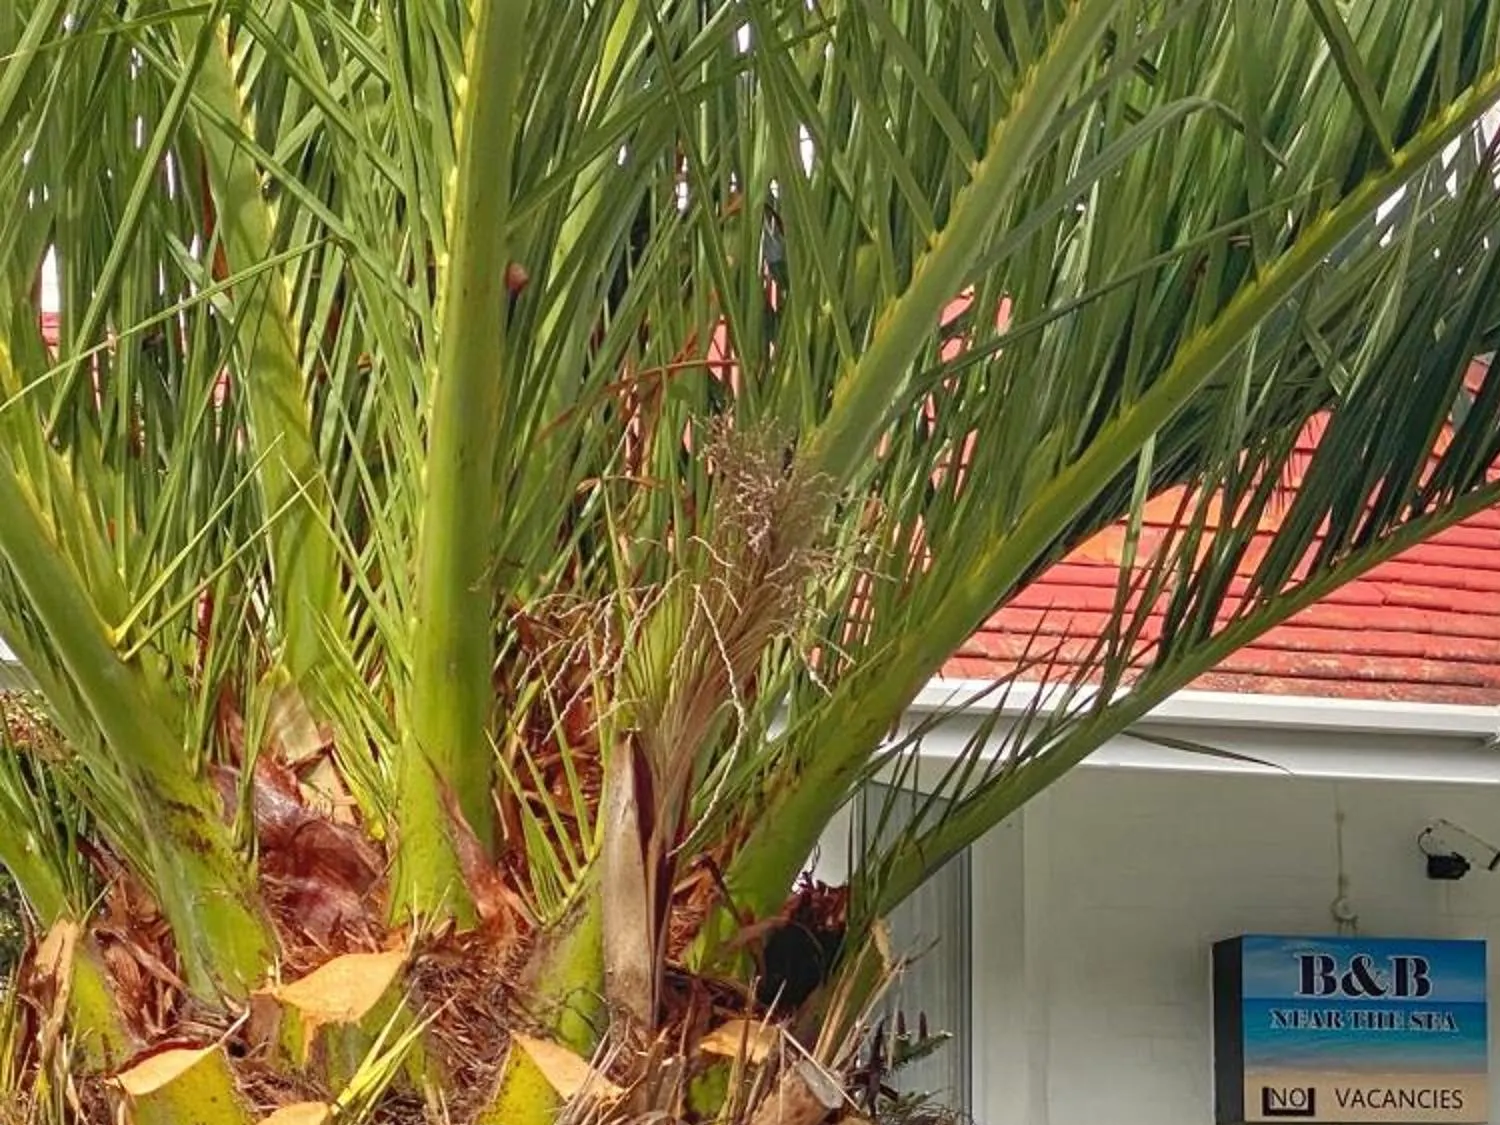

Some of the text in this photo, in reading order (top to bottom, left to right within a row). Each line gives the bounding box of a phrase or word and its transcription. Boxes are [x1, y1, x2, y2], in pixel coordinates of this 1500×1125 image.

[1294, 952, 1432, 999] B&B
[1269, 1008, 1459, 1033] NEAR THE SEA
[1271, 1087, 1463, 1109] NO VACANCIES
